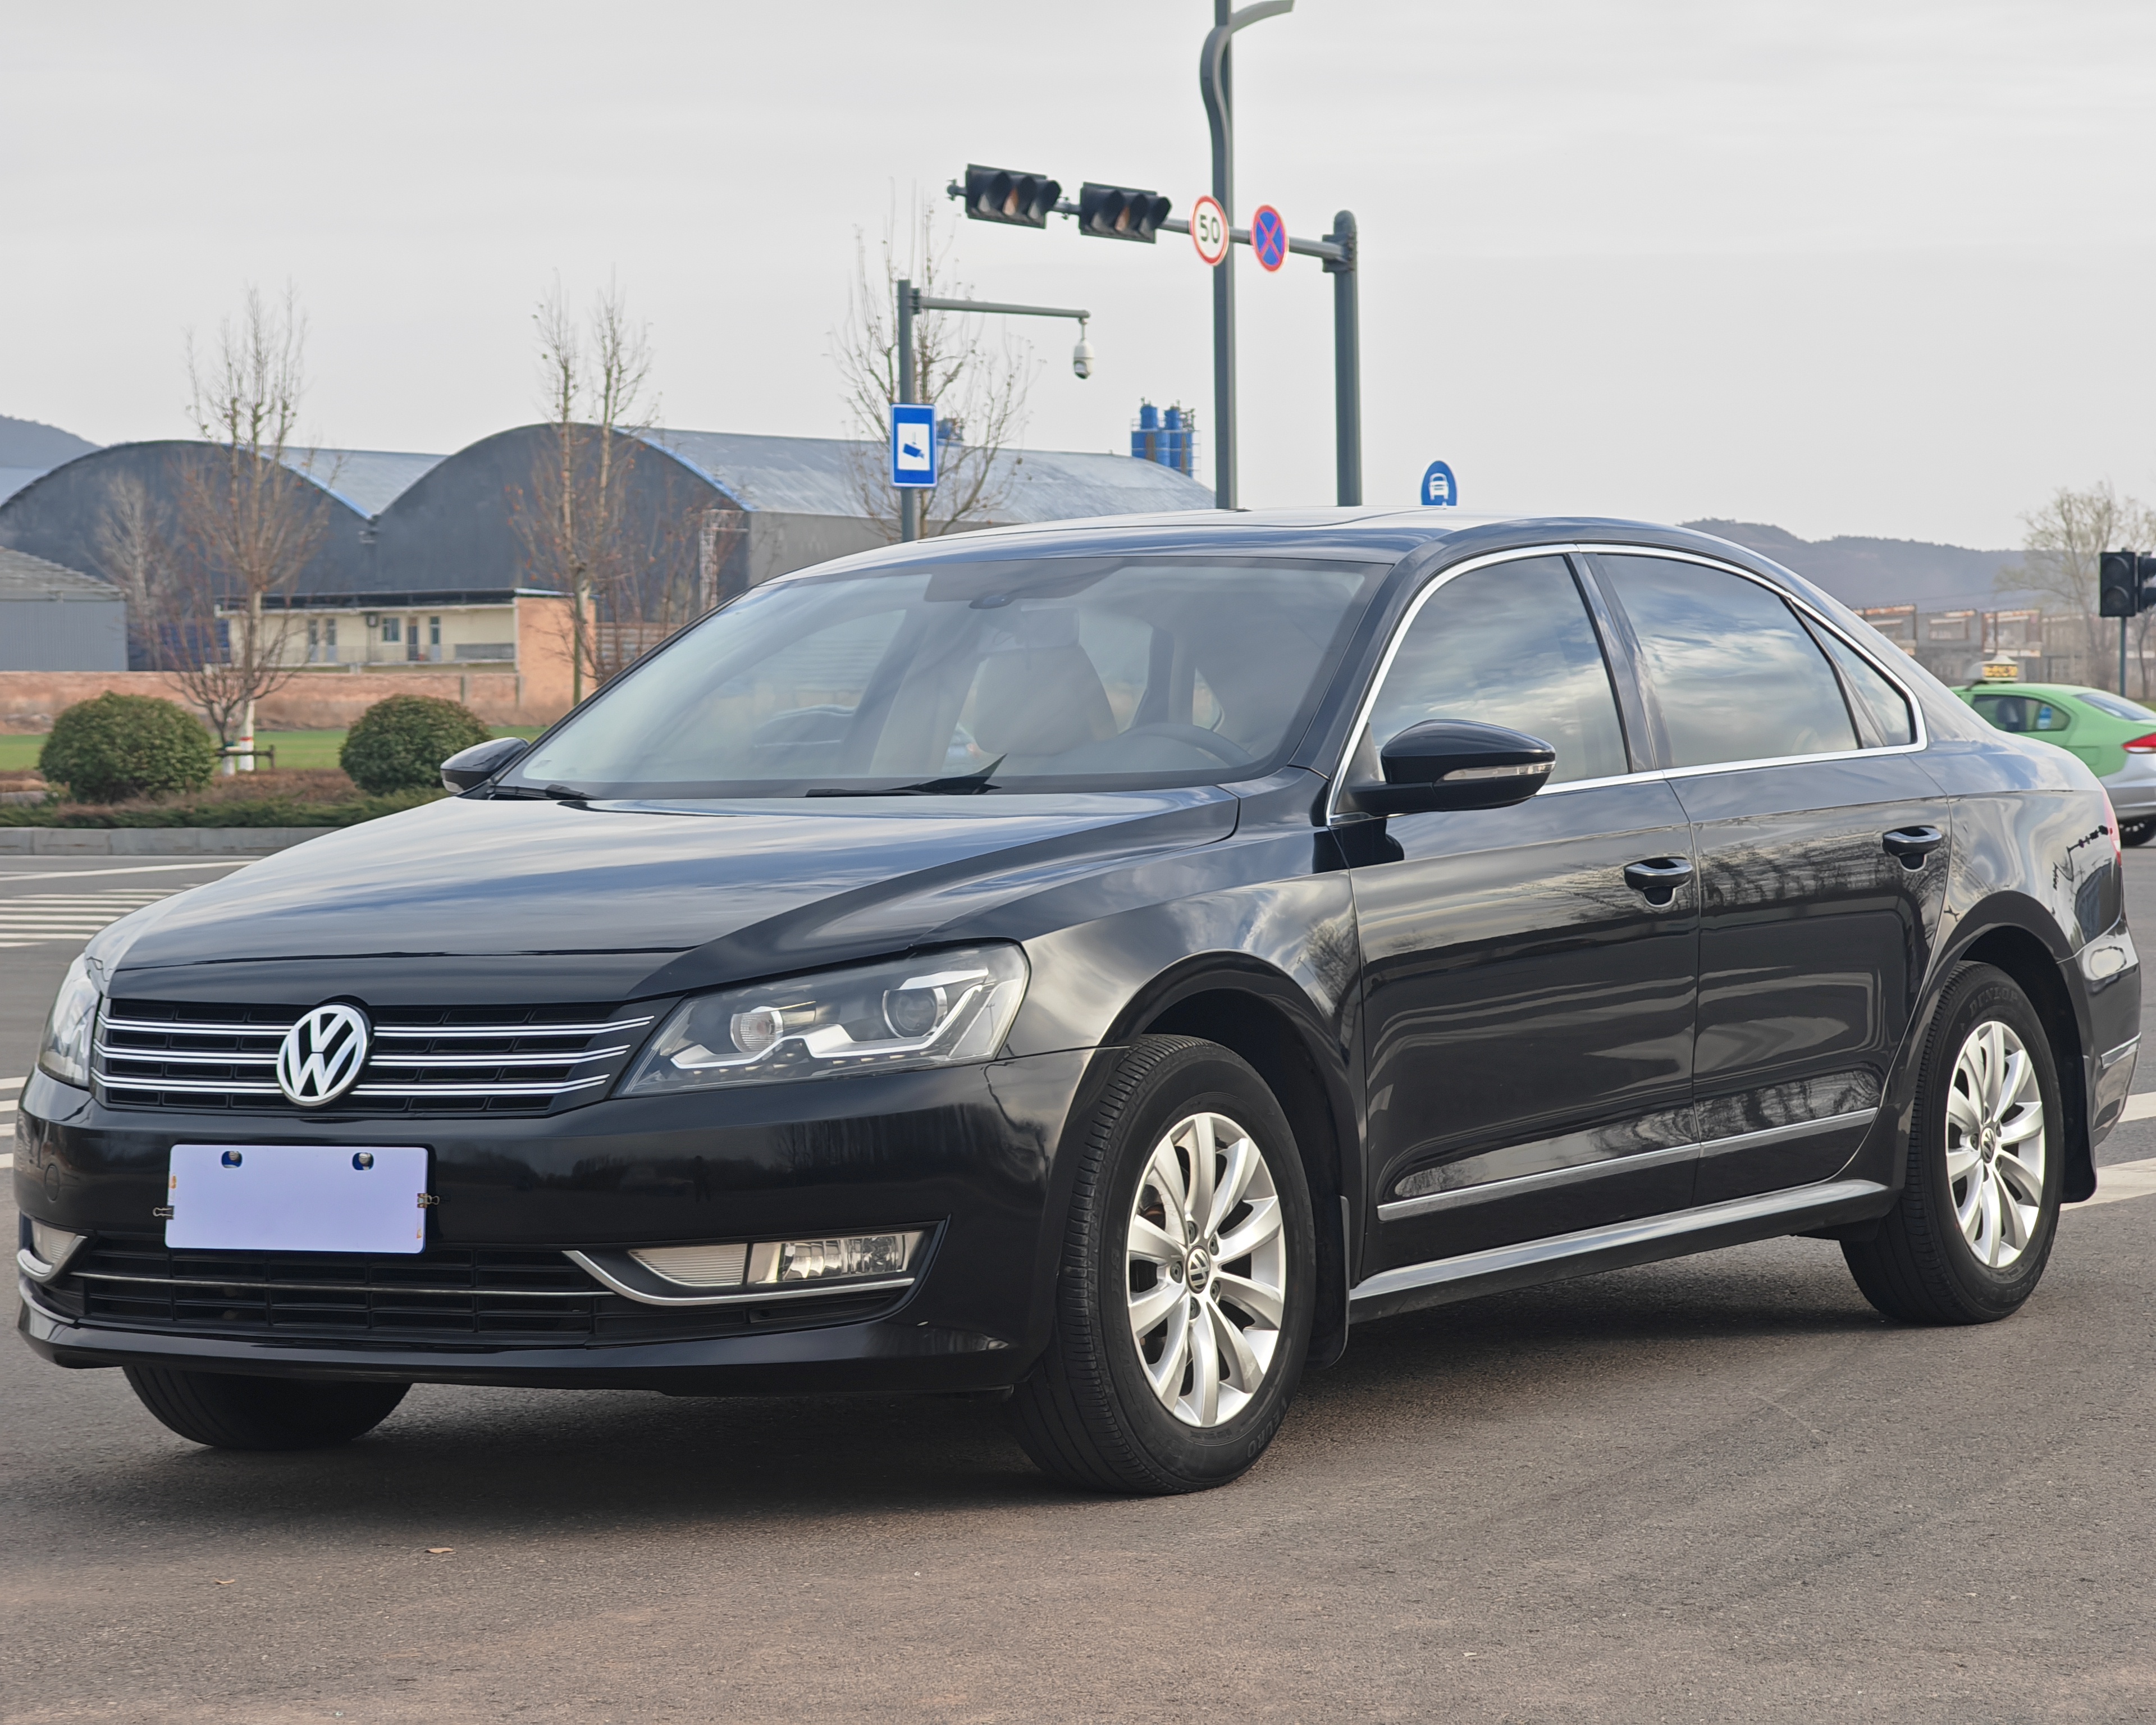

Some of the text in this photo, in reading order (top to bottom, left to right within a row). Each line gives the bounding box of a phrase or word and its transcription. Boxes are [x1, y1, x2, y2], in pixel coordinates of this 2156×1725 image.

[1199, 214, 1221, 244] 50
[1969, 986, 2018, 1017] DUNLOP
[284, 1010, 361, 1098] VW
